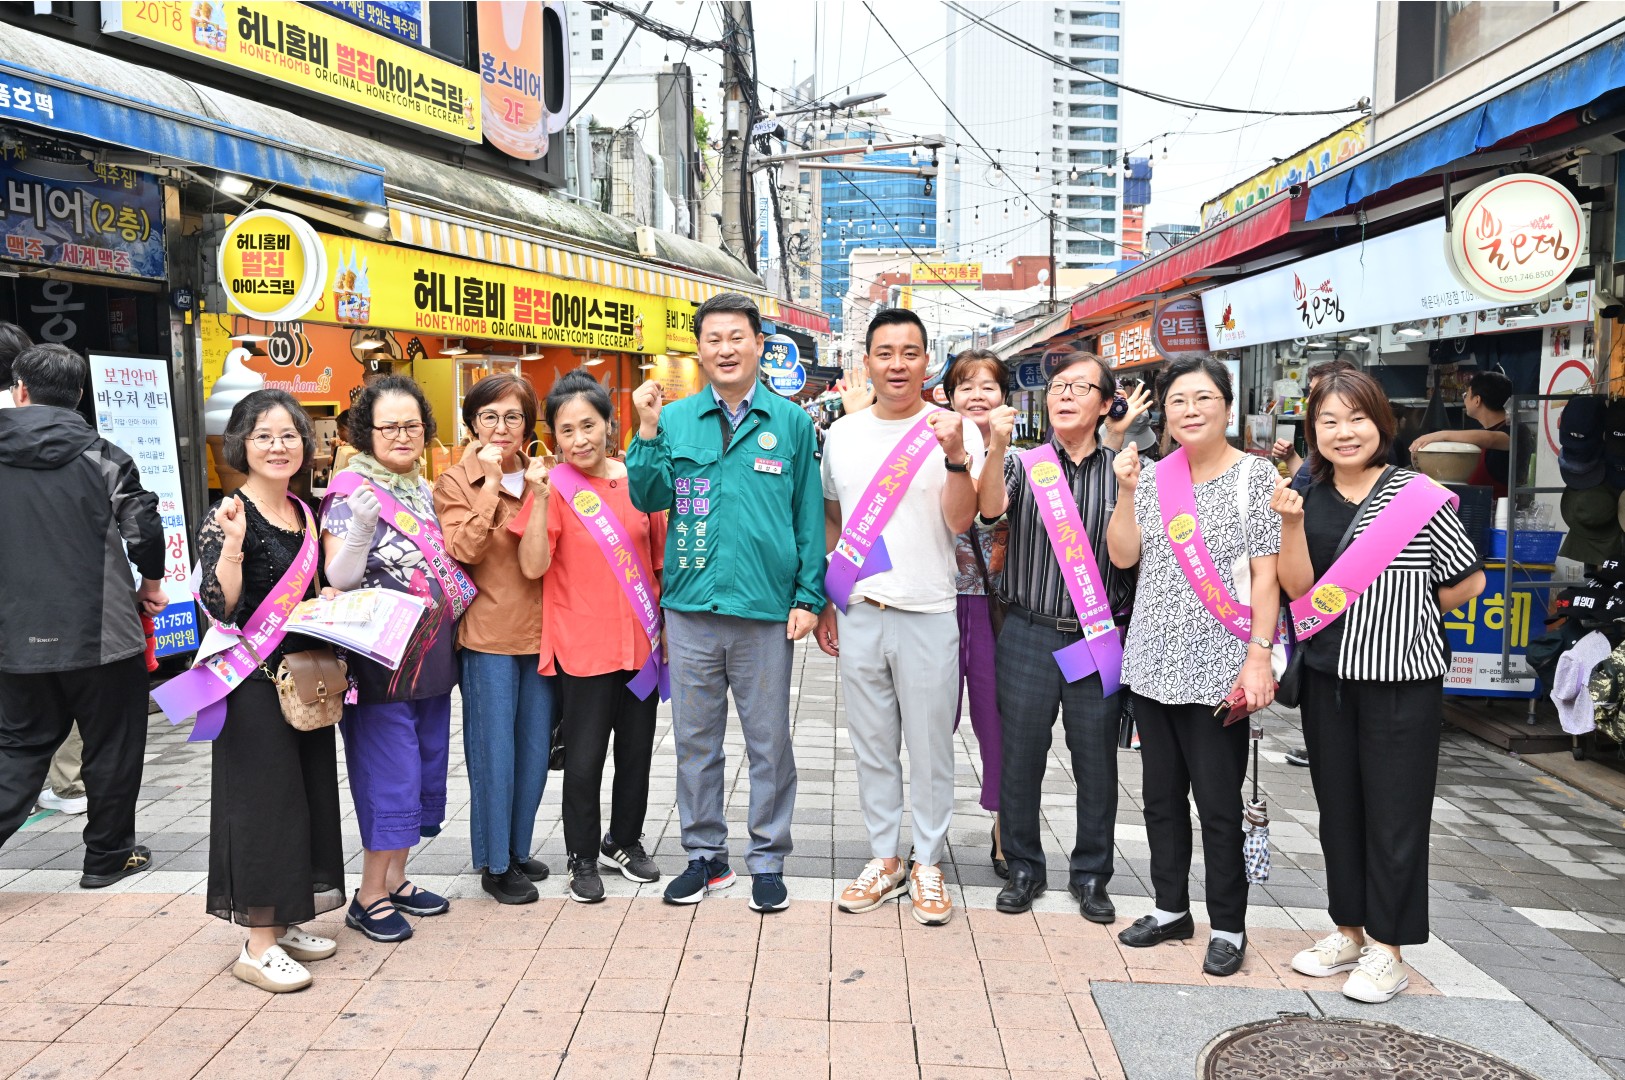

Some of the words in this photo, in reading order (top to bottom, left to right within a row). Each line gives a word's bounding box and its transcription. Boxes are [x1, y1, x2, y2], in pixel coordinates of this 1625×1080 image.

[136, 1, 183, 31] 2018
[366, 2, 390, 30] 맛있는
[393, 13, 418, 40] 맥주집!
[237, 7, 328, 69] 허니홈비
[336, 42, 463, 115] 벌집아이스크림
[239, 41, 310, 75] HONEYHOMB
[315, 68, 361, 92] ORIGINAL
[366, 84, 421, 112] HONEYCOMB
[424, 104, 464, 126] ICECREAM
[481, 52, 541, 102] 홍스비어
[503, 98, 523, 125] 2F
[94, 162, 137, 189] 맥주집!
[0, 181, 83, 234] 비어
[91, 200, 149, 242] (2층)
[6, 234, 45, 261] 맥주
[62, 242, 130, 272] 세계맥주
[236, 234, 290, 251] 허니홈비
[241, 251, 285, 278] 벌집
[1499, 270, 1554, 284] T.051.746.8500
[232, 278, 295, 296] 아이스크림
[413, 268, 506, 321] 허니홈비
[513, 285, 634, 336] 벌집아이스크림
[1421, 290, 1459, 309] 해운대시장점
[1461, 290, 1477, 302] T.05
[415, 311, 487, 333] HONEYHOMB
[491, 321, 537, 339] ORIGINAL
[541, 329, 594, 345] HONEYCOMB
[597, 333, 634, 349] ICECREAM
[765, 351, 786, 367] 어묵
[104, 367, 158, 387] 보건안마
[97, 390, 139, 408] 바우처
[143, 391, 169, 409] 센터
[139, 451, 165, 460] 허리골반
[905, 428, 934, 457] 행복한
[141, 465, 160, 474] 오십견
[162, 464, 174, 474] 교정
[878, 455, 911, 496] 추석
[162, 501, 175, 510] 연속
[857, 492, 887, 536] 보내세요
[1045, 487, 1067, 521] 행복한
[1056, 521, 1086, 563] 추석
[1073, 563, 1098, 608] 보내세요
[594, 515, 620, 546] 행복한
[612, 544, 641, 584] 추석
[633, 581, 655, 622] 보내세요
[1183, 543, 1207, 580] 행복한
[1200, 578, 1238, 619] 추석
[274, 570, 304, 617] 추석
[153, 611, 193, 630] 31-7578
[241, 611, 282, 652] 보내세요
